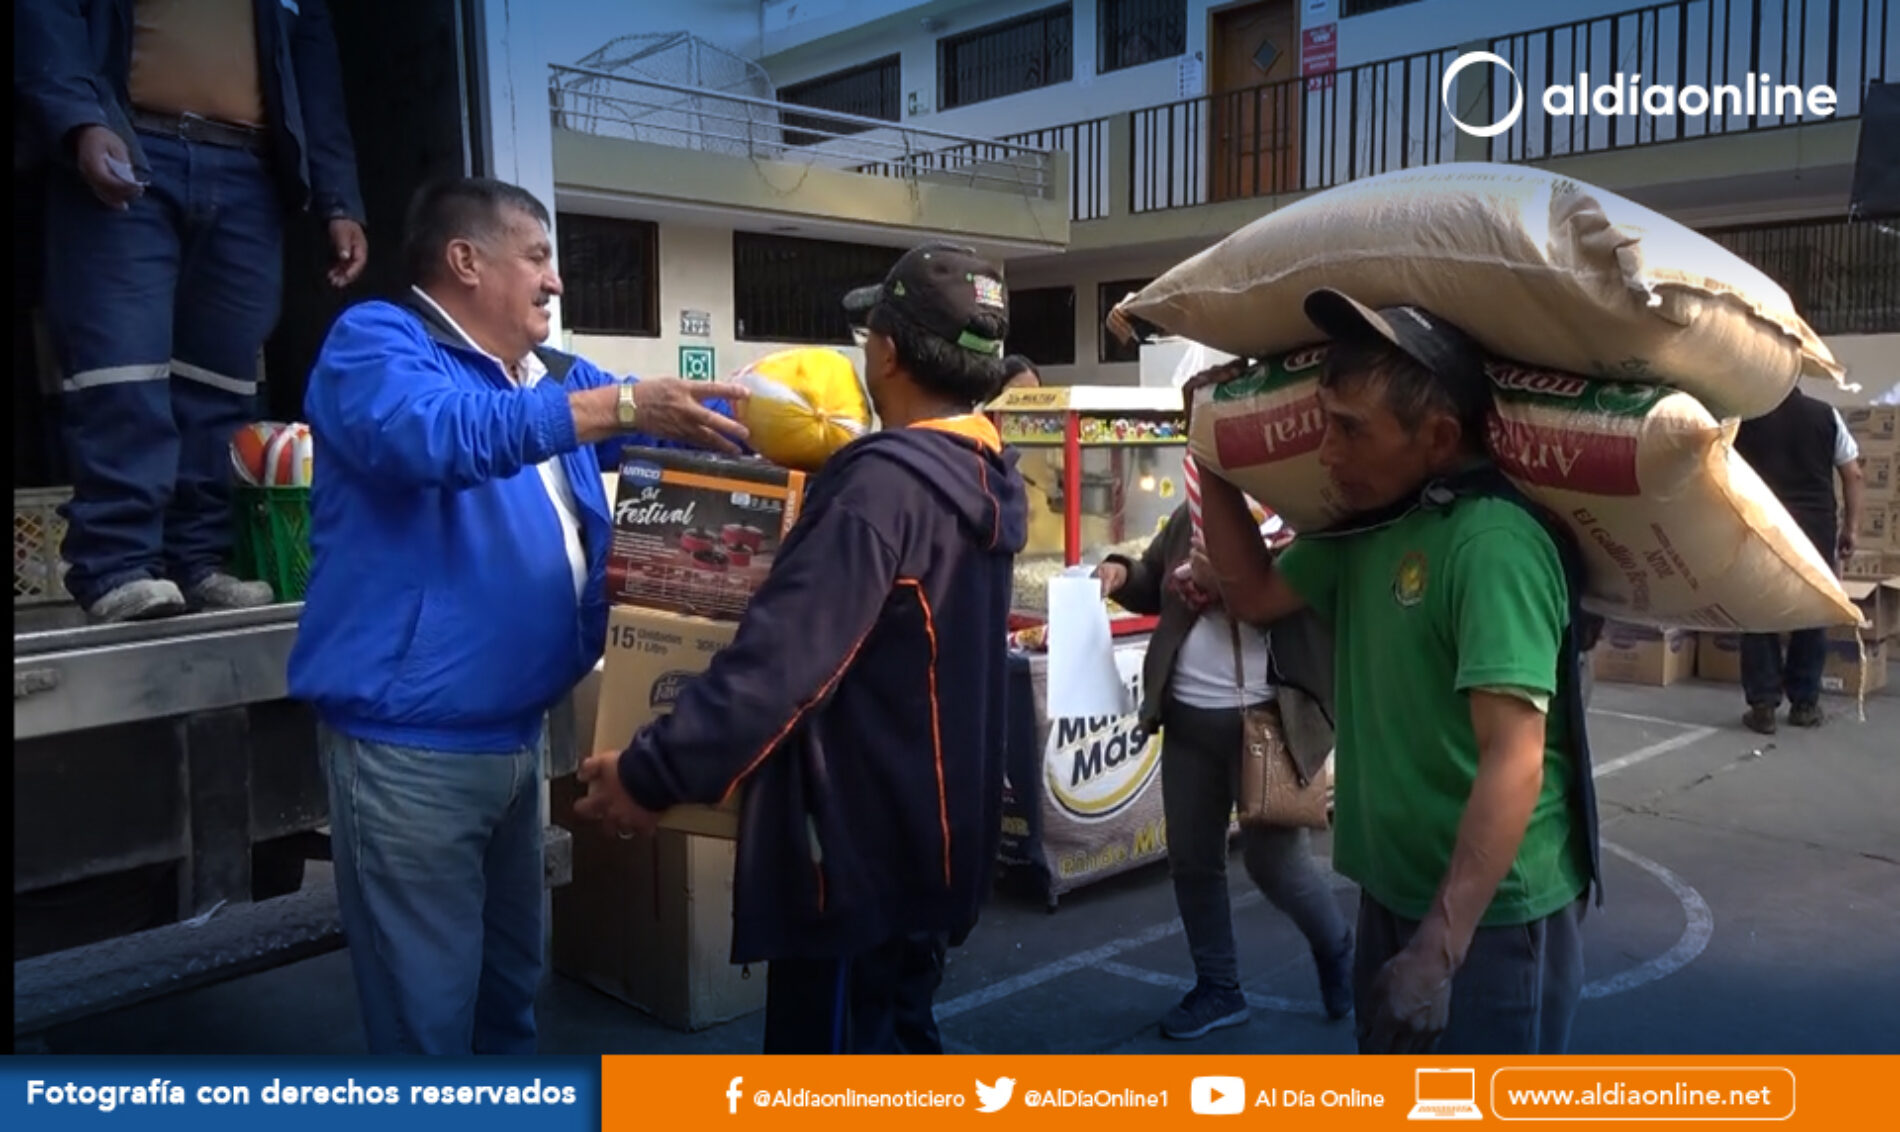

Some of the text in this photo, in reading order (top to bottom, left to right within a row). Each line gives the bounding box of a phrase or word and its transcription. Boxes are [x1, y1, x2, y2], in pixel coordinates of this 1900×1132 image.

[616, 499, 696, 526] Festival
[1572, 507, 1598, 526] El
[611, 624, 634, 649] 15
[1071, 724, 1150, 787] Más
